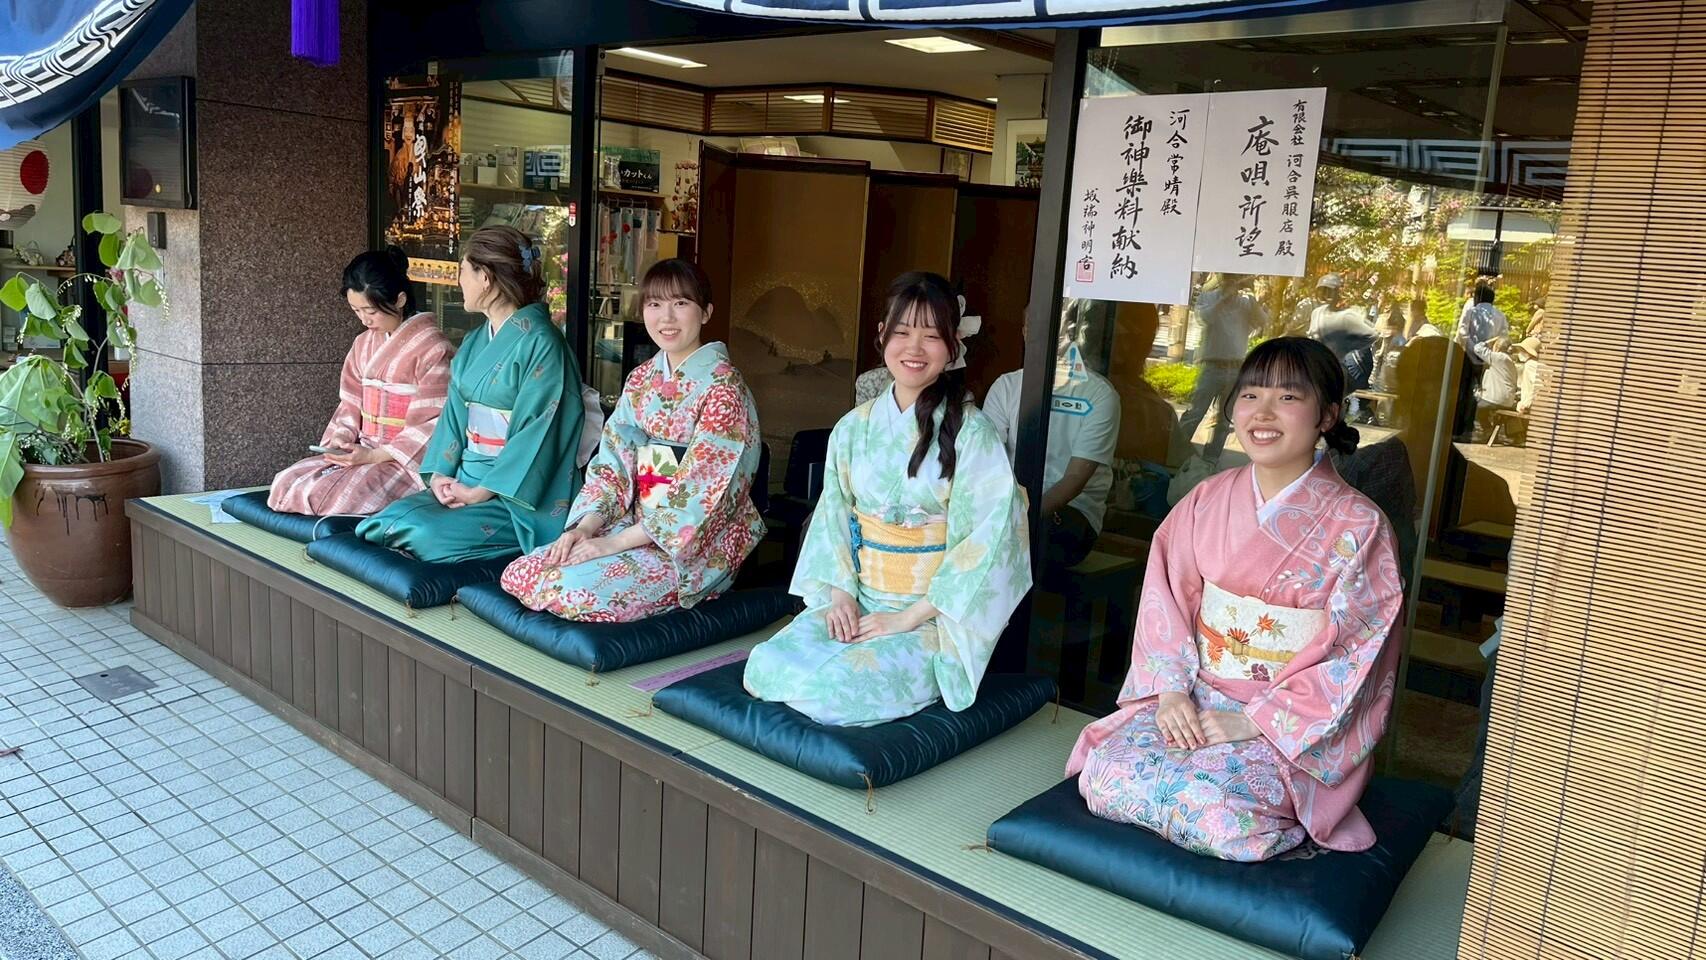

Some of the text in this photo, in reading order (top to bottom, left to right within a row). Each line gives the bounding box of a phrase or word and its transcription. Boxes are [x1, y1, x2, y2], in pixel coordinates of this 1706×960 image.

[1290, 99, 1308, 146] 有限会社
[621, 169, 652, 179] カットくん
[1235, 115, 1280, 258] 庵唄所望
[1274, 239, 1295, 257] 殿
